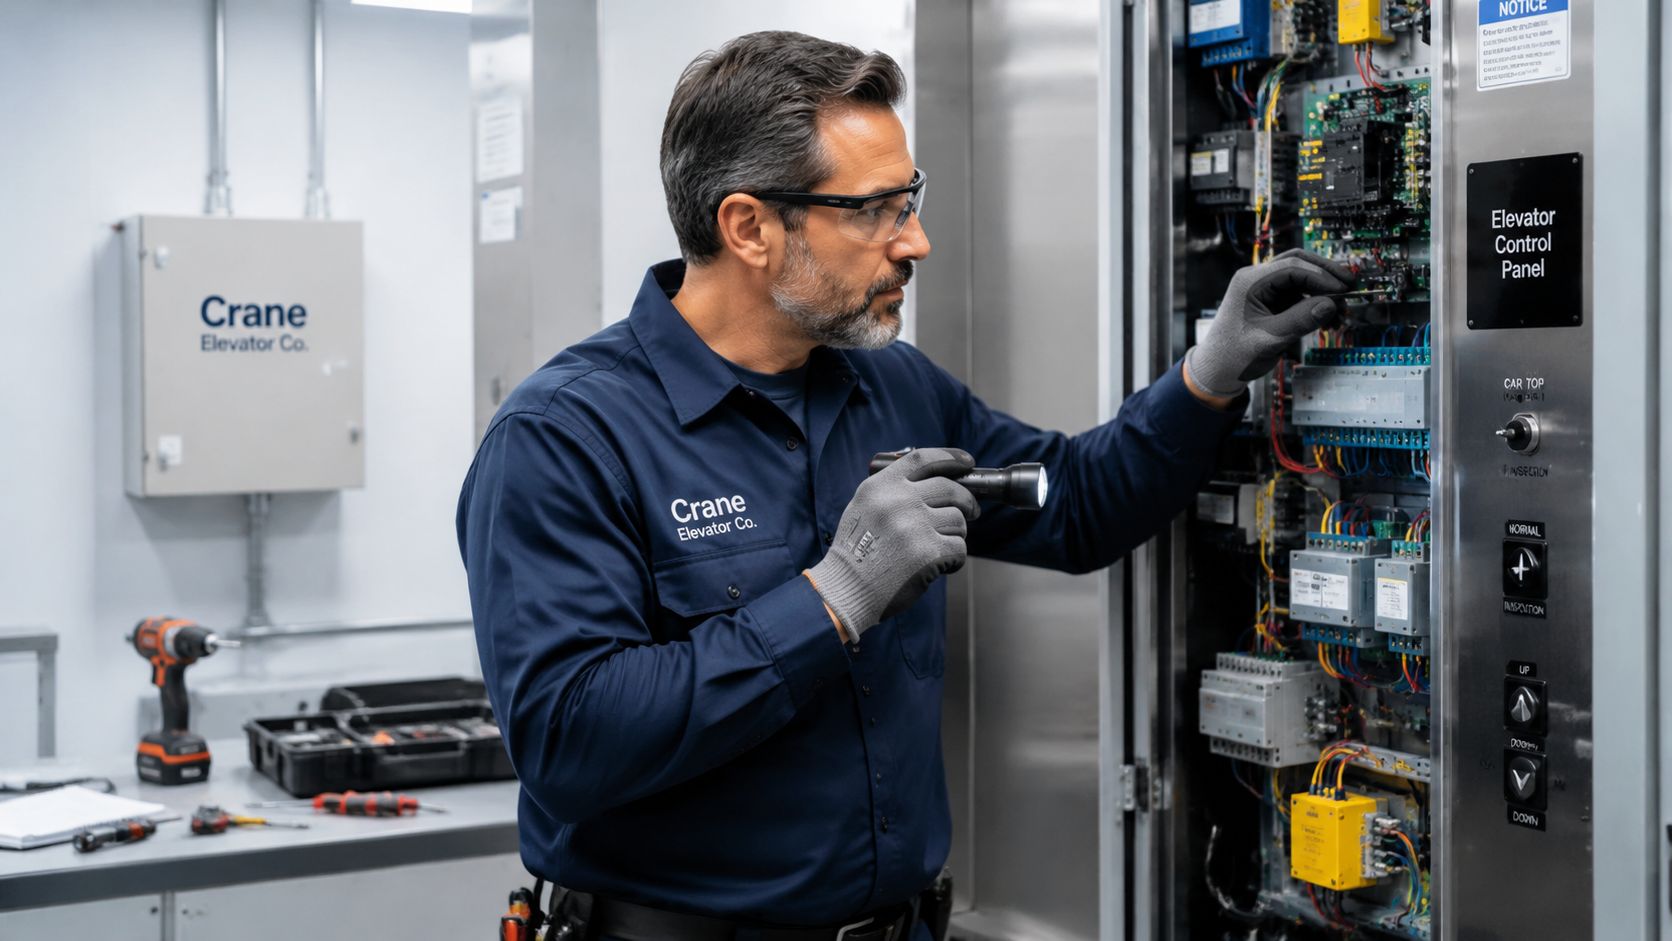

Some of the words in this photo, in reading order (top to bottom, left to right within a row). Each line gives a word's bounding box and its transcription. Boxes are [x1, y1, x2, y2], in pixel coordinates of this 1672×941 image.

[1499, 0, 1547, 17] NOTICE
[1492, 208, 1556, 229] Elevator
[1495, 232, 1552, 254] Control
[1502, 258, 1545, 279] Panel
[200, 295, 307, 328] Crane
[201, 334, 274, 351] Elevator
[279, 334, 309, 351] Co.
[1504, 378, 1523, 389] CAR
[1526, 377, 1544, 389] TOP
[671, 495, 746, 523] Crane
[677, 521, 732, 541] Elevator
[734, 516, 758, 530] Co.
[1519, 665, 1530, 675] UP
